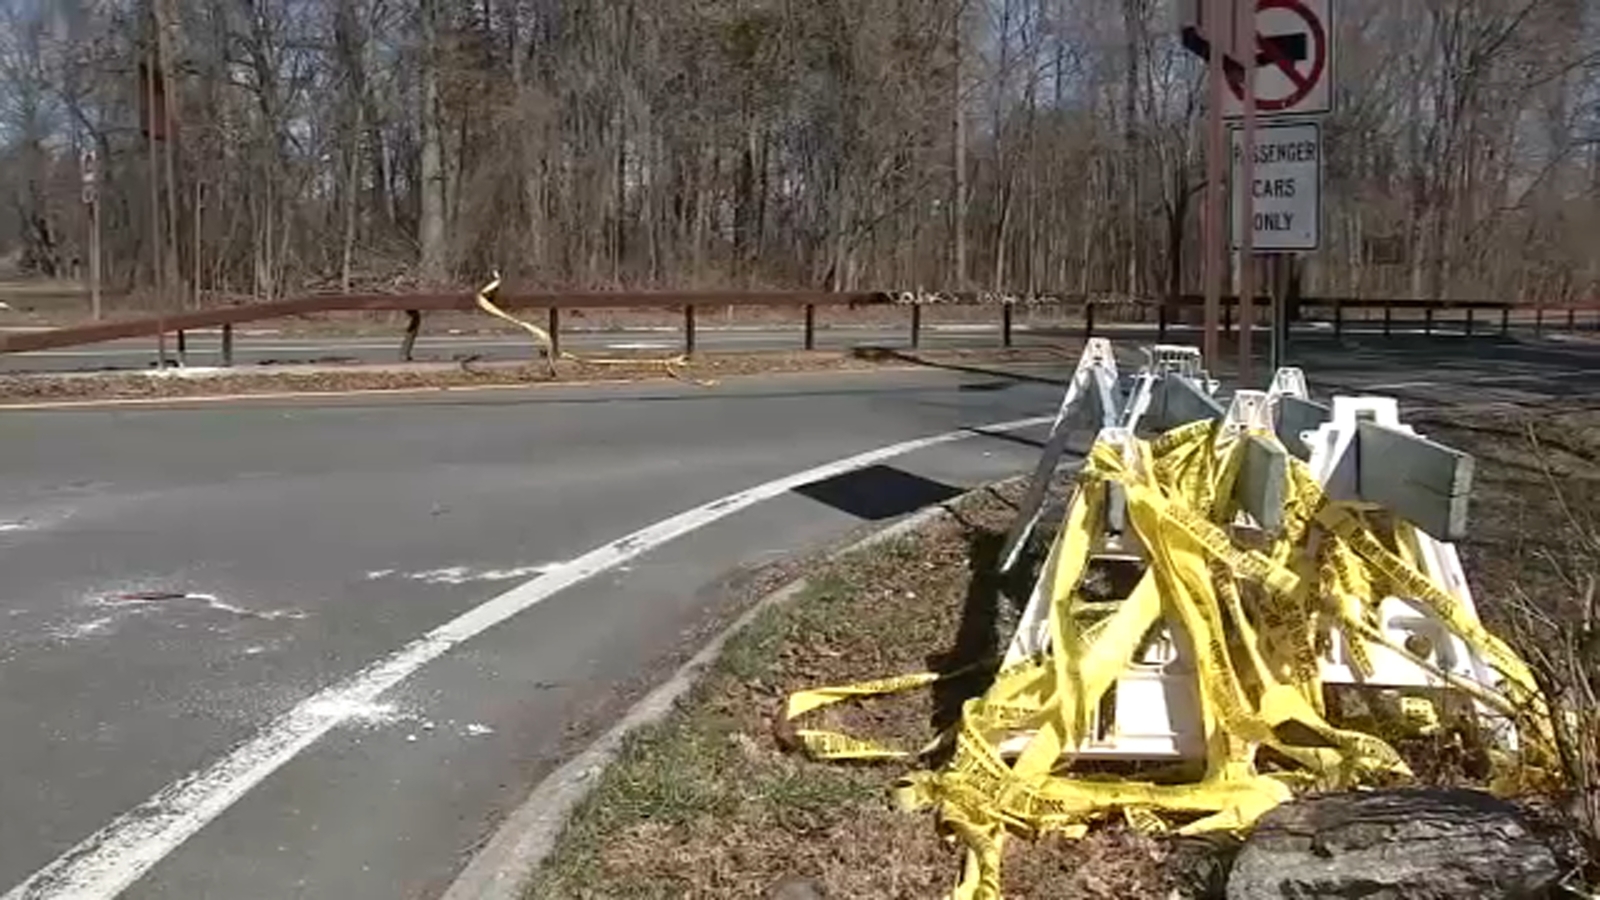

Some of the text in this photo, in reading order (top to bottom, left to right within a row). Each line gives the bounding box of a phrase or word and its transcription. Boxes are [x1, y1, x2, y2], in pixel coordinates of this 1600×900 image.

[1234, 140, 1316, 164] PSSENGER
[1252, 178, 1296, 199] CARS
[1254, 211, 1295, 232] ONLY
